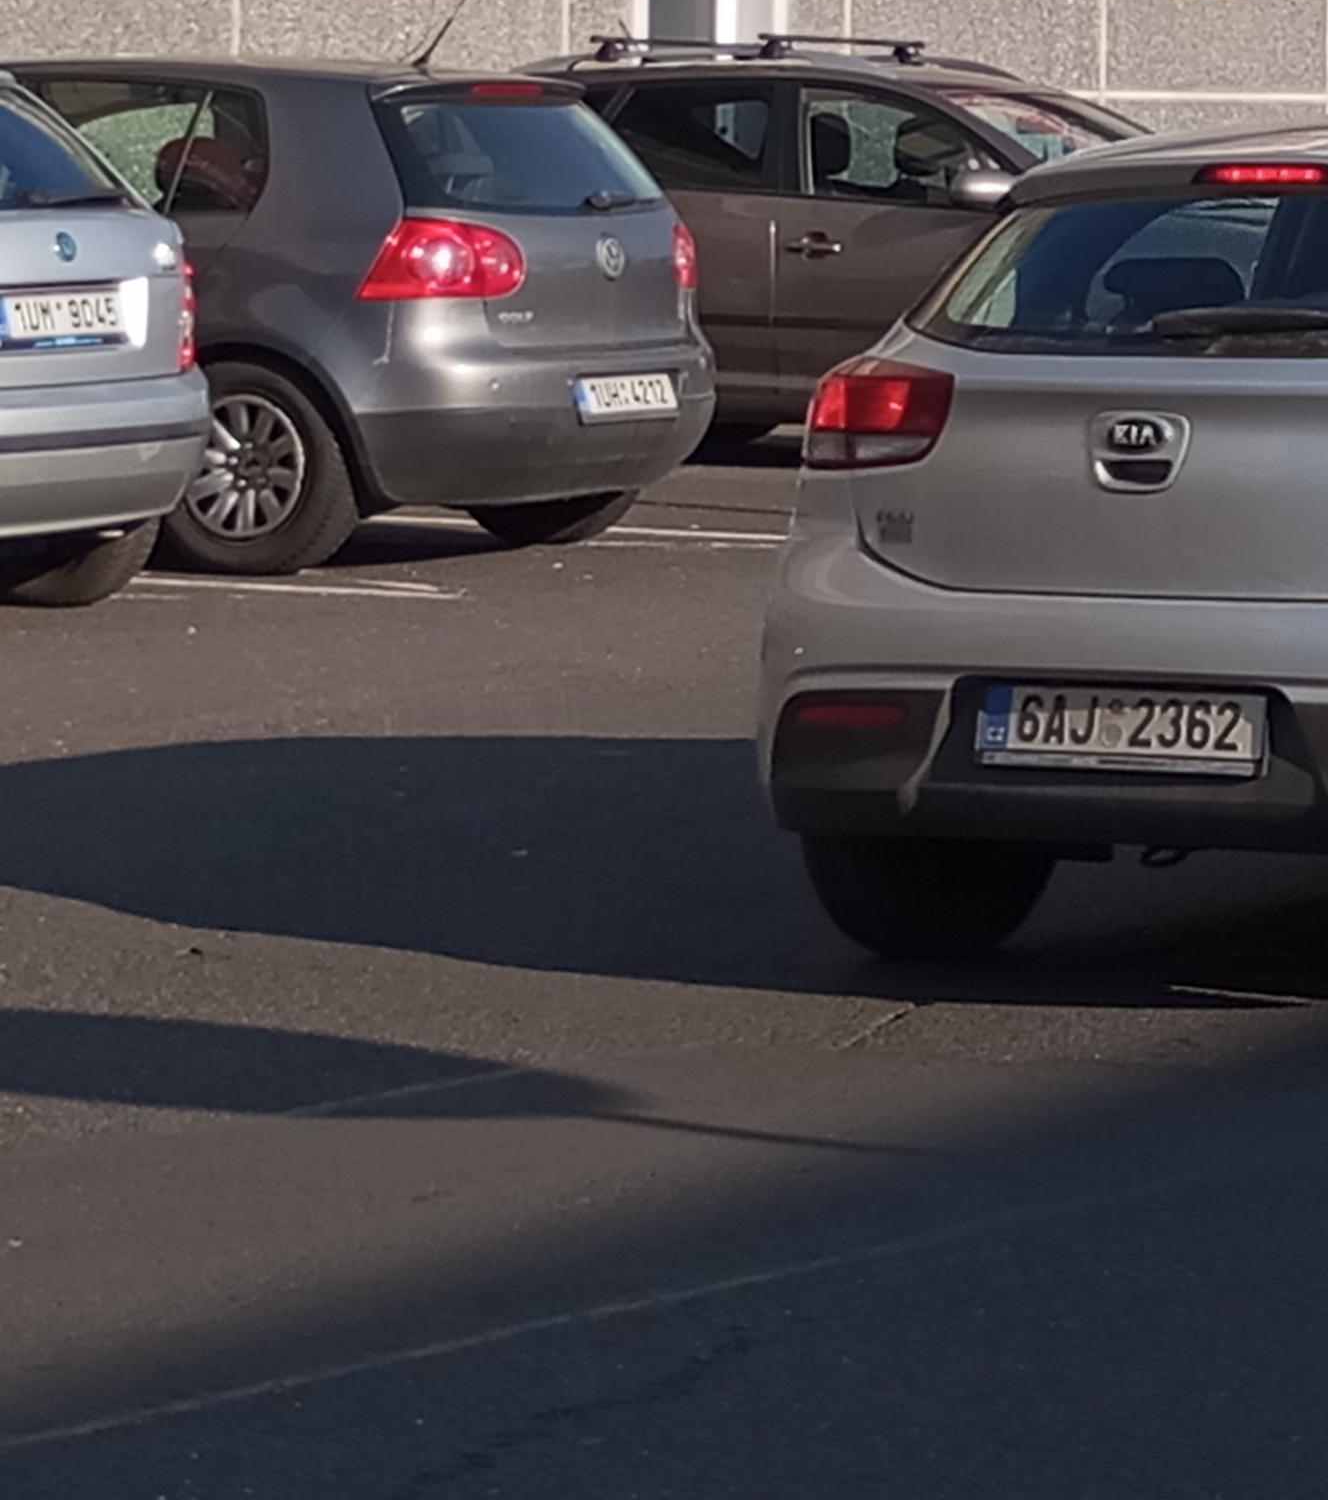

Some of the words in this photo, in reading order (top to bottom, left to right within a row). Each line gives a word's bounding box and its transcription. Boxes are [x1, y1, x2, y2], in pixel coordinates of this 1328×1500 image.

[67, 296, 118, 329] 9045
[1113, 423, 1158, 447] KIA
[1016, 694, 1099, 745] 6AJ
[1128, 697, 1242, 752] 2362
